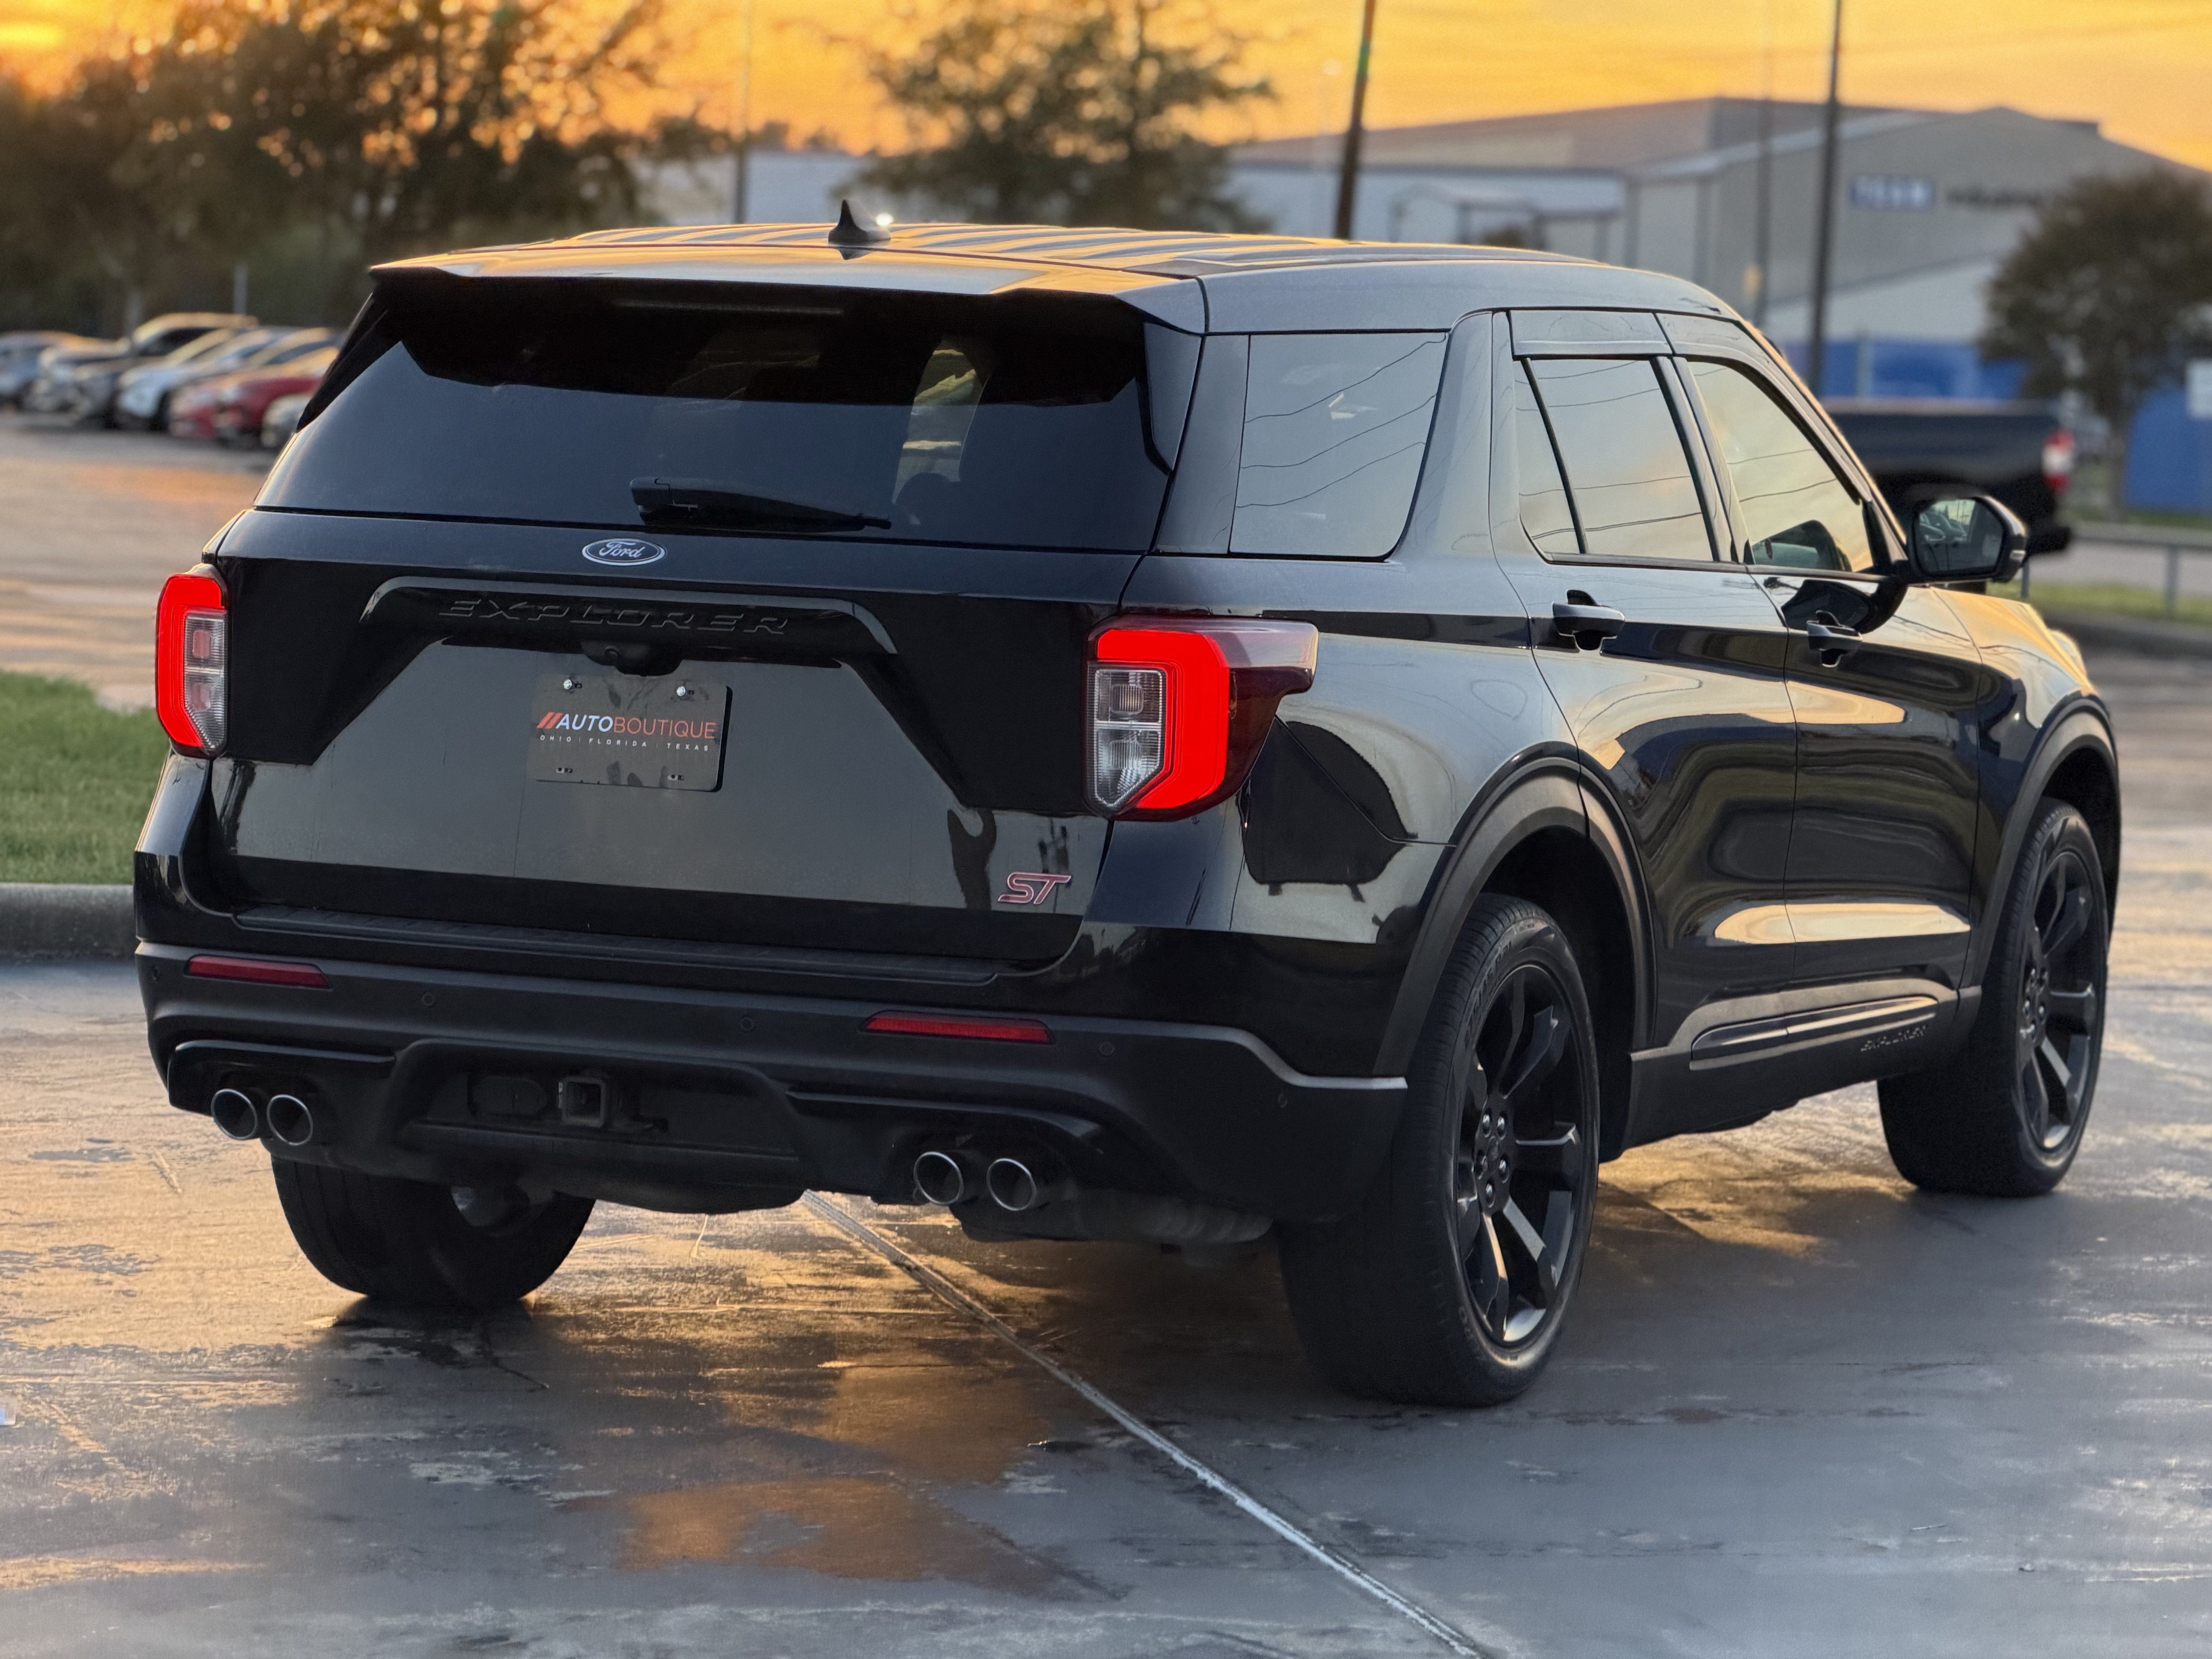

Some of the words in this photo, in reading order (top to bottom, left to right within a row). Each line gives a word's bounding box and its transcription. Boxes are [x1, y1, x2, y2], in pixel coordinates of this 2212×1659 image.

[599, 541, 646, 558] Ford
[439, 599, 788, 635] EXPLORER
[589, 737, 647, 748] FLORIDA
[667, 742, 709, 752] TEXAS
[998, 871, 1072, 905] ST
